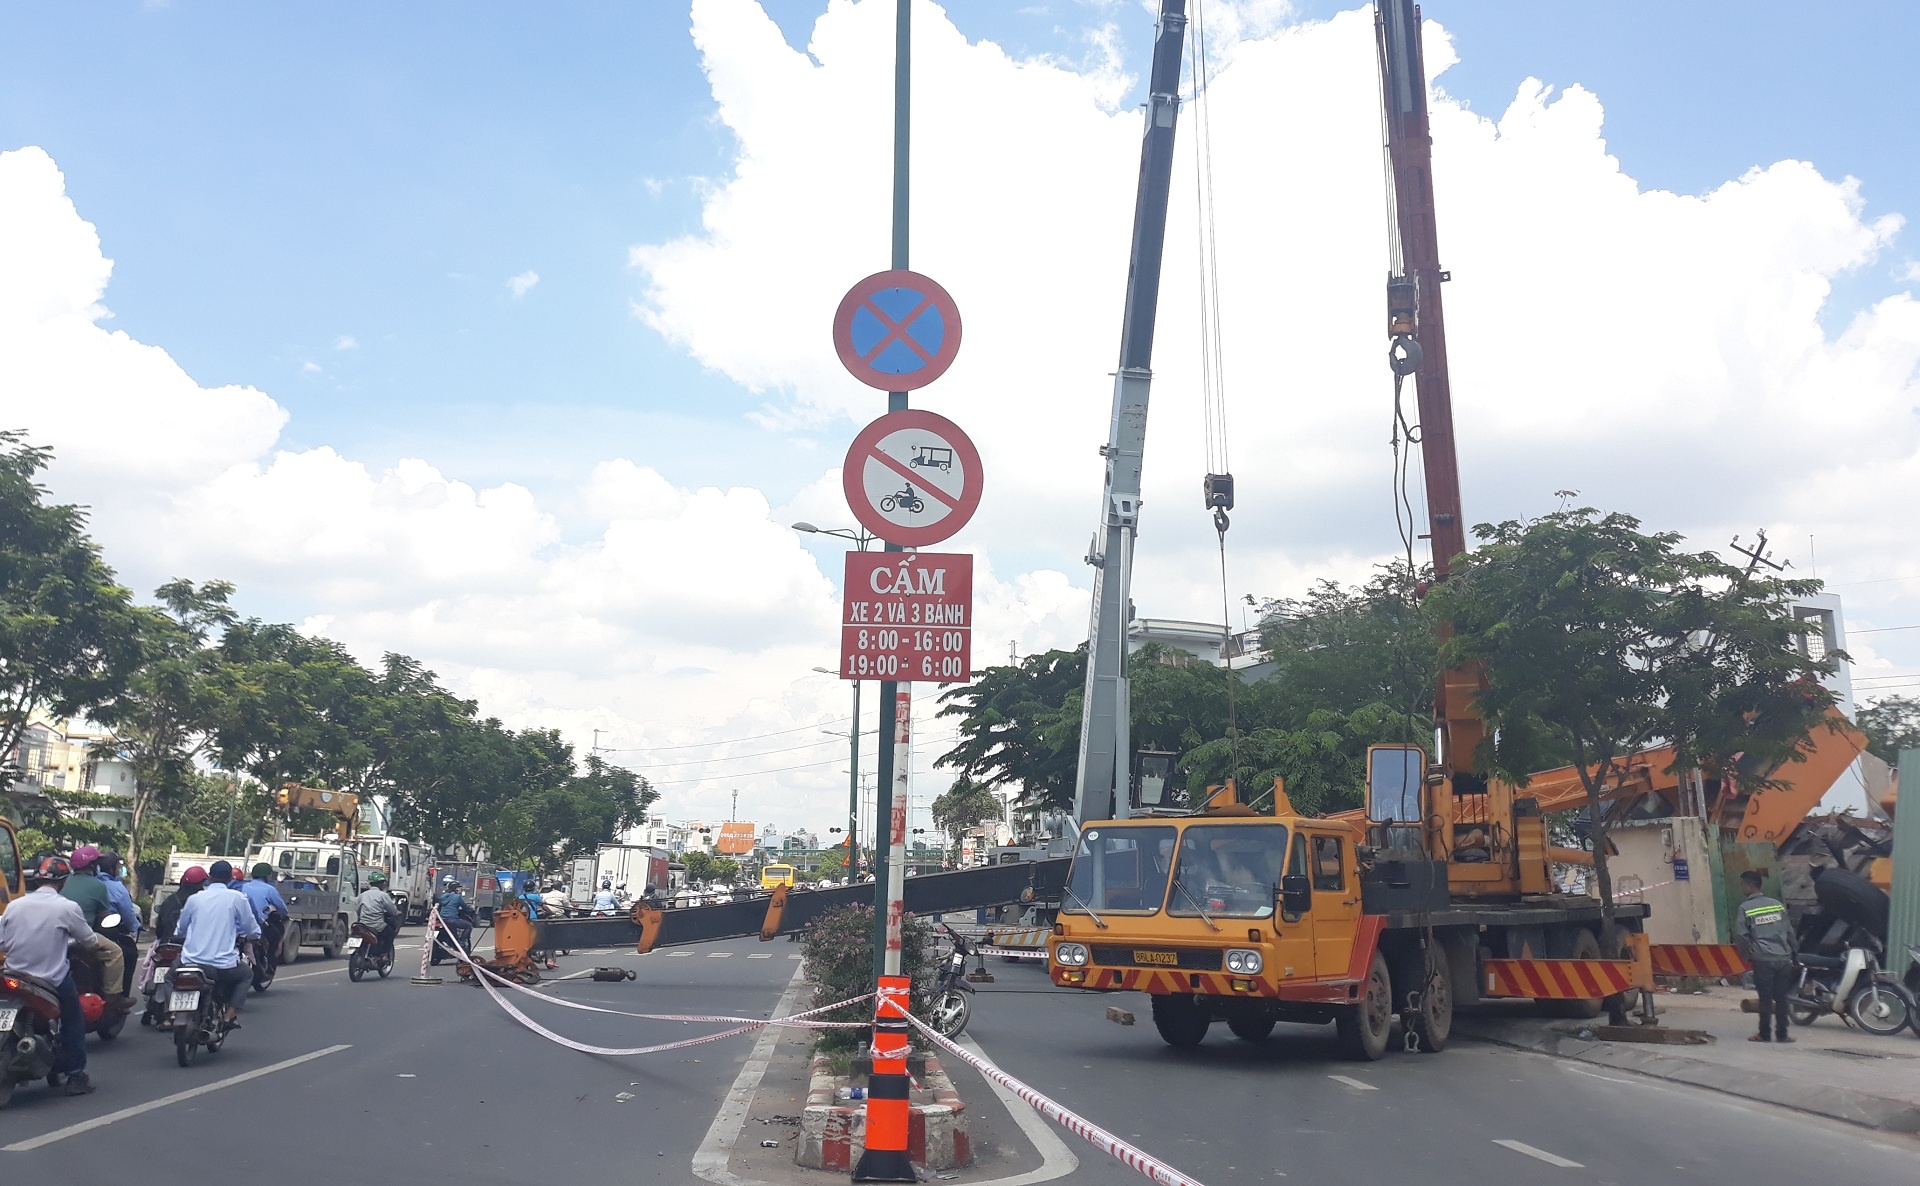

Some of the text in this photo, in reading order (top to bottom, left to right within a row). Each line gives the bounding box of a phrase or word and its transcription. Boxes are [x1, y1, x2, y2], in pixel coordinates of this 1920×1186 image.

[870, 554, 946, 595] CẤM
[850, 597, 964, 624] XE 2 VÀ 3 BÁNH
[921, 655, 962, 677] 6:00
